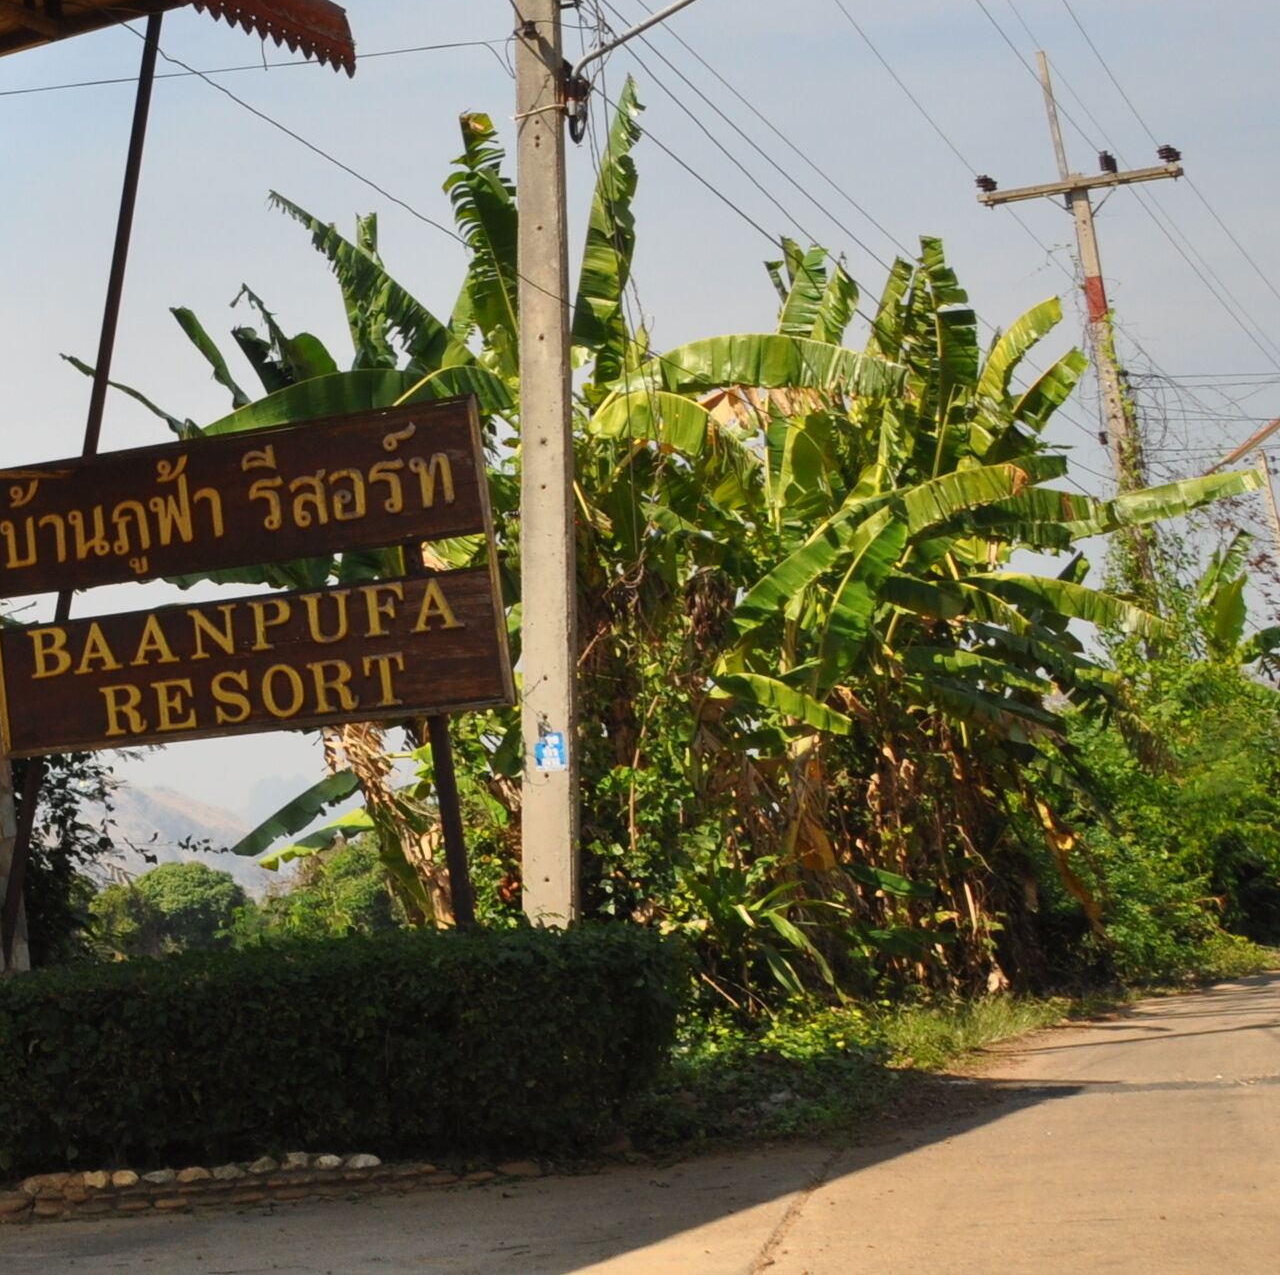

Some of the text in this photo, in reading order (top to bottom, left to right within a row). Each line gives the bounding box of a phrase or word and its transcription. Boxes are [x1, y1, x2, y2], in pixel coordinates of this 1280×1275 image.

[0, 422, 457, 574] บ้านภูฟ้า รีสอร์ท
[26, 578, 466, 679] BAANPUFA
[99, 652, 406, 737] RESORT
